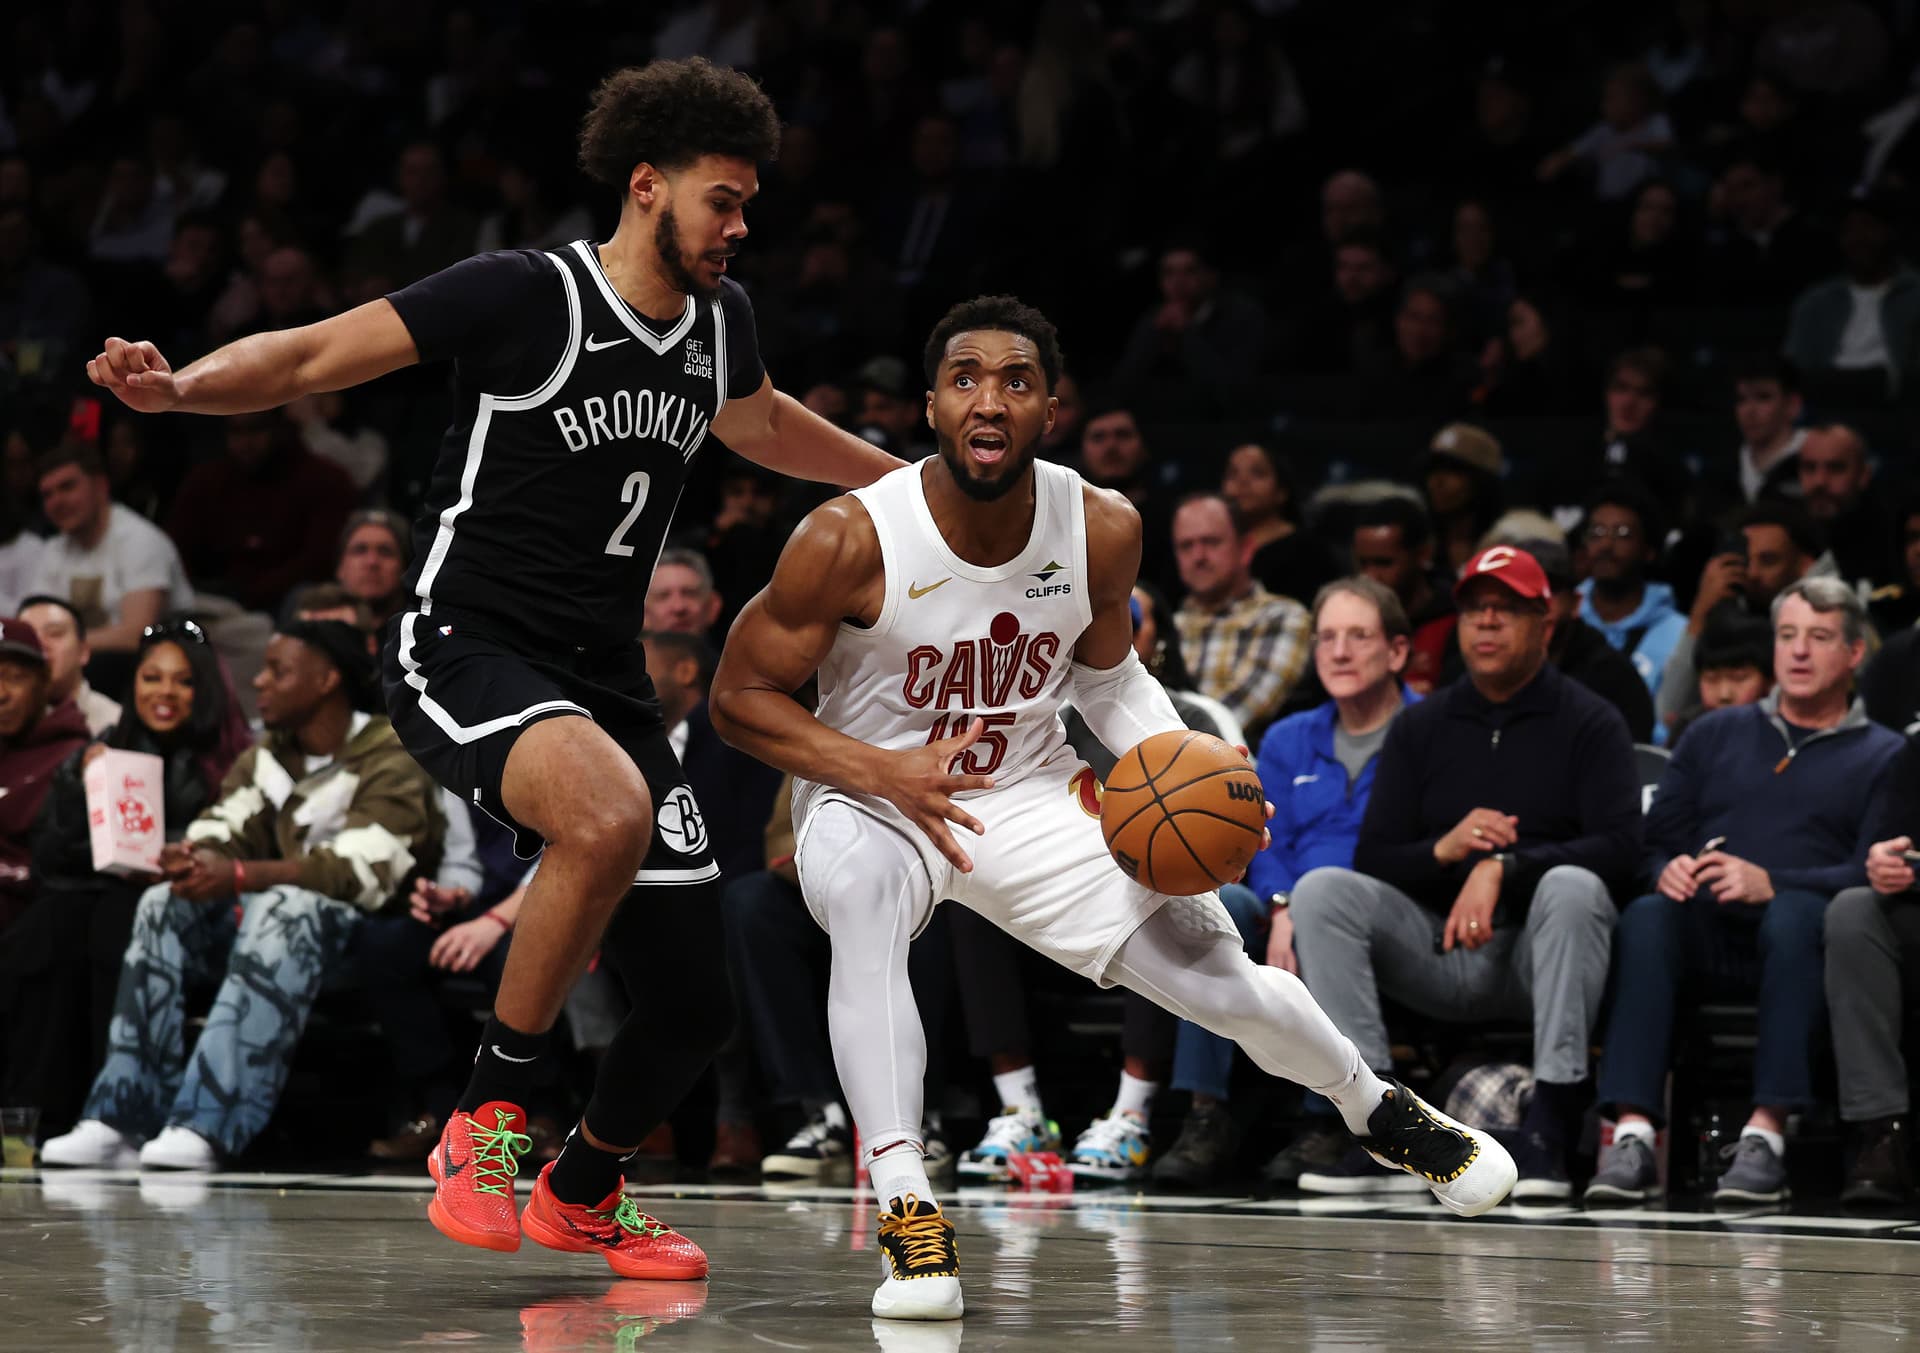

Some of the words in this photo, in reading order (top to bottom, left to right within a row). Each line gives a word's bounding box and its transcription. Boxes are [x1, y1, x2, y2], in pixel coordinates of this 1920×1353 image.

[686, 338, 703, 352] GET
[686, 350, 712, 367] YOUR
[684, 363, 713, 379] GUIDE
[604, 471, 650, 557] 2
[1477, 546, 1516, 572] C
[1026, 584, 1071, 599] CLIFFS
[903, 632, 1061, 709] CAVS
[676, 794, 700, 846] B
